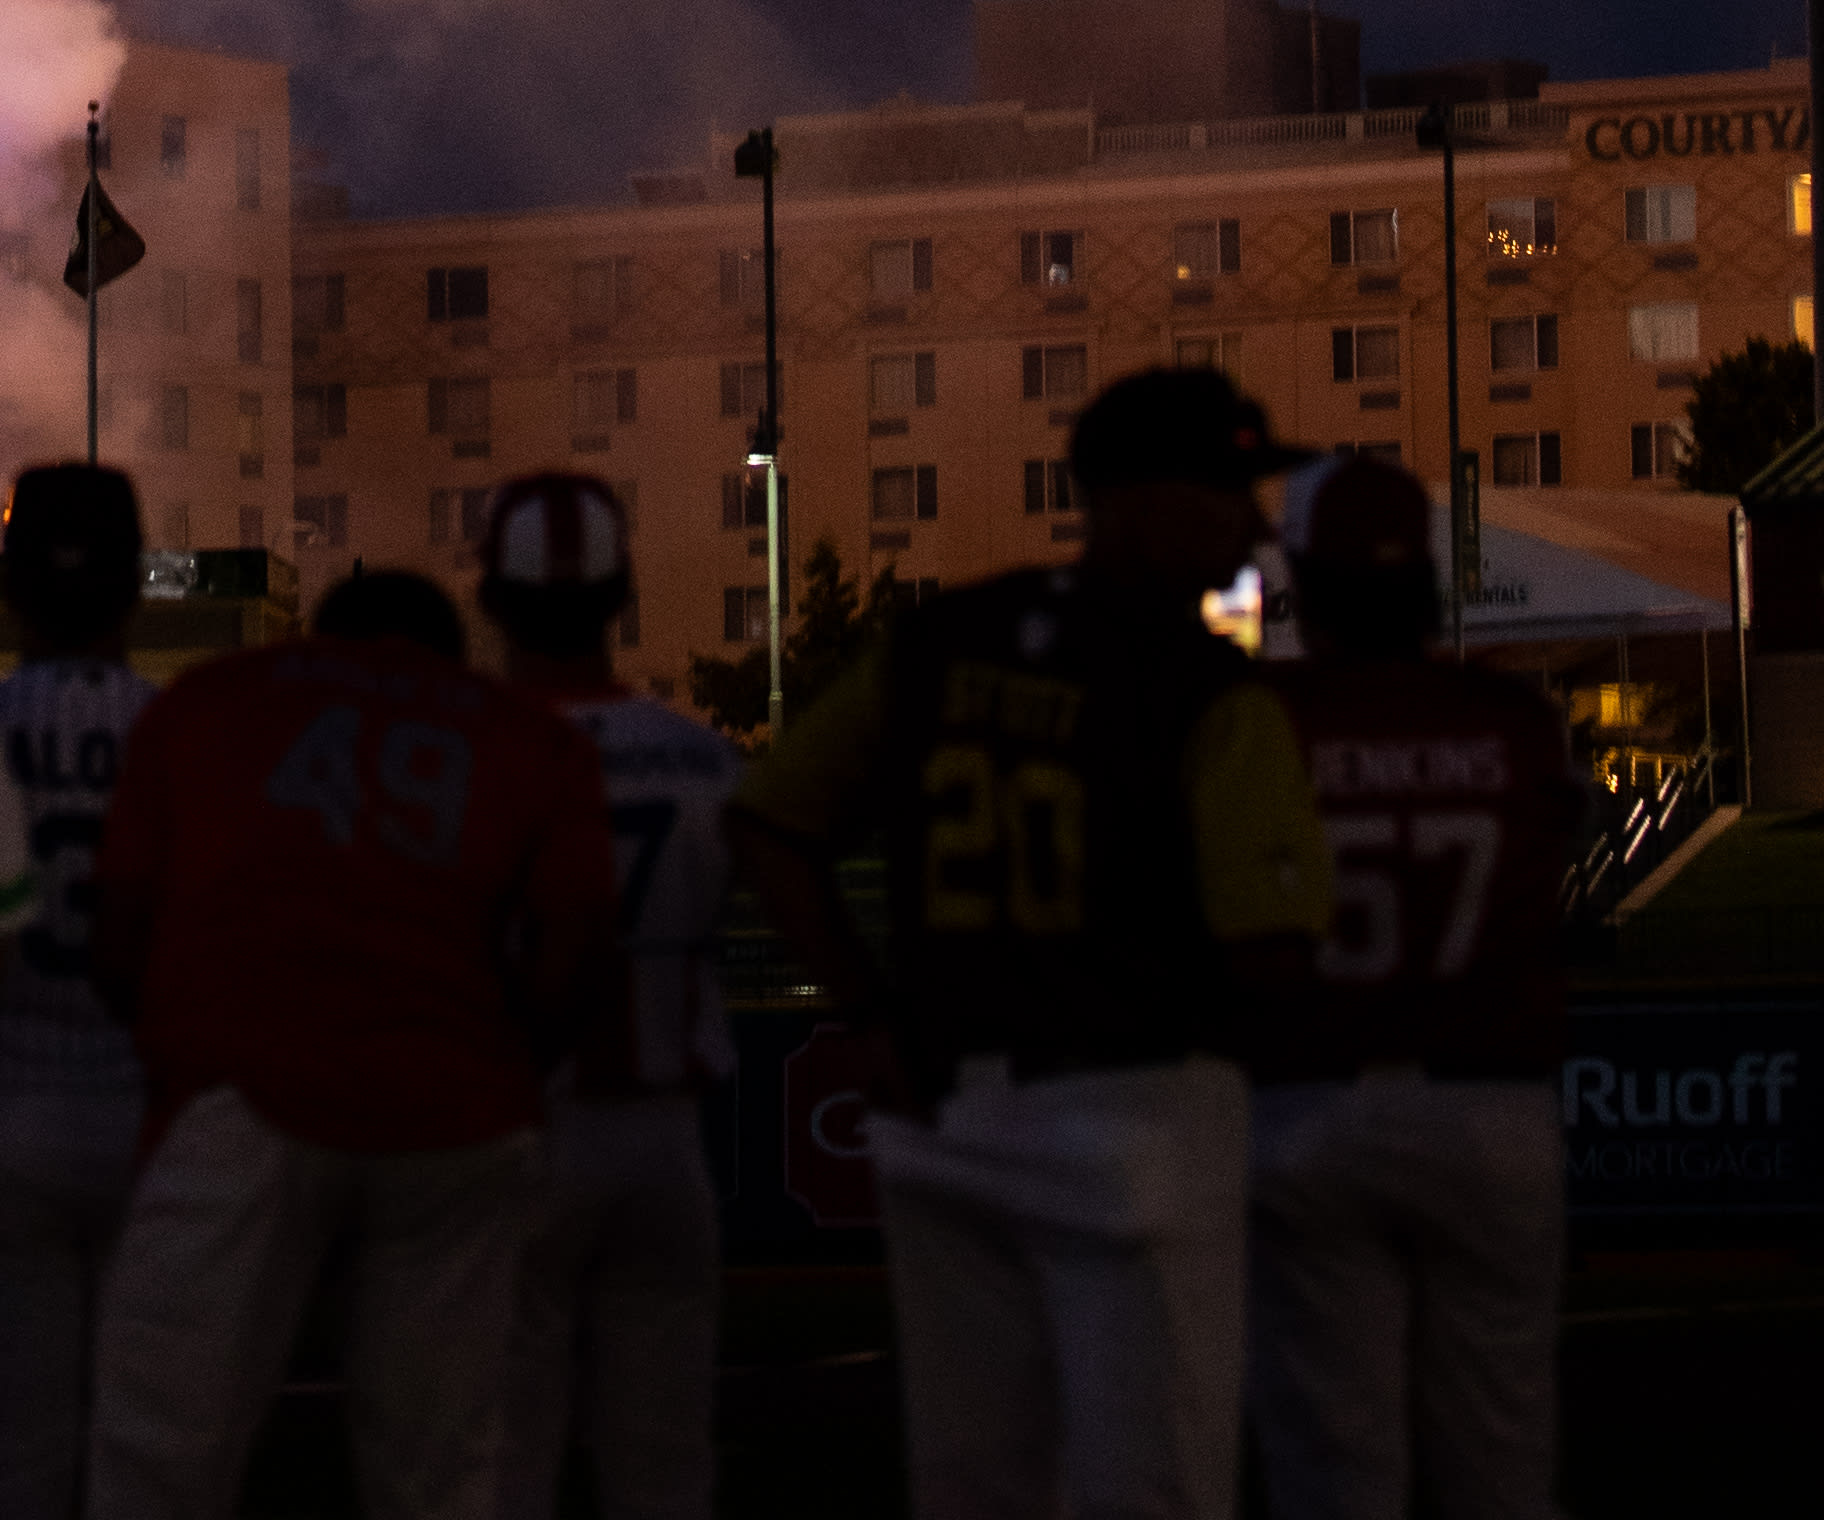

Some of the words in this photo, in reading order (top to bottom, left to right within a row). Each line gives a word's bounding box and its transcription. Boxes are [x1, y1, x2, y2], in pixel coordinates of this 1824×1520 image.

[266, 704, 474, 868] 49
[921, 740, 1084, 932] 20
[1313, 812, 1504, 980] 57
[1562, 1049, 1798, 1128] Ruoff
